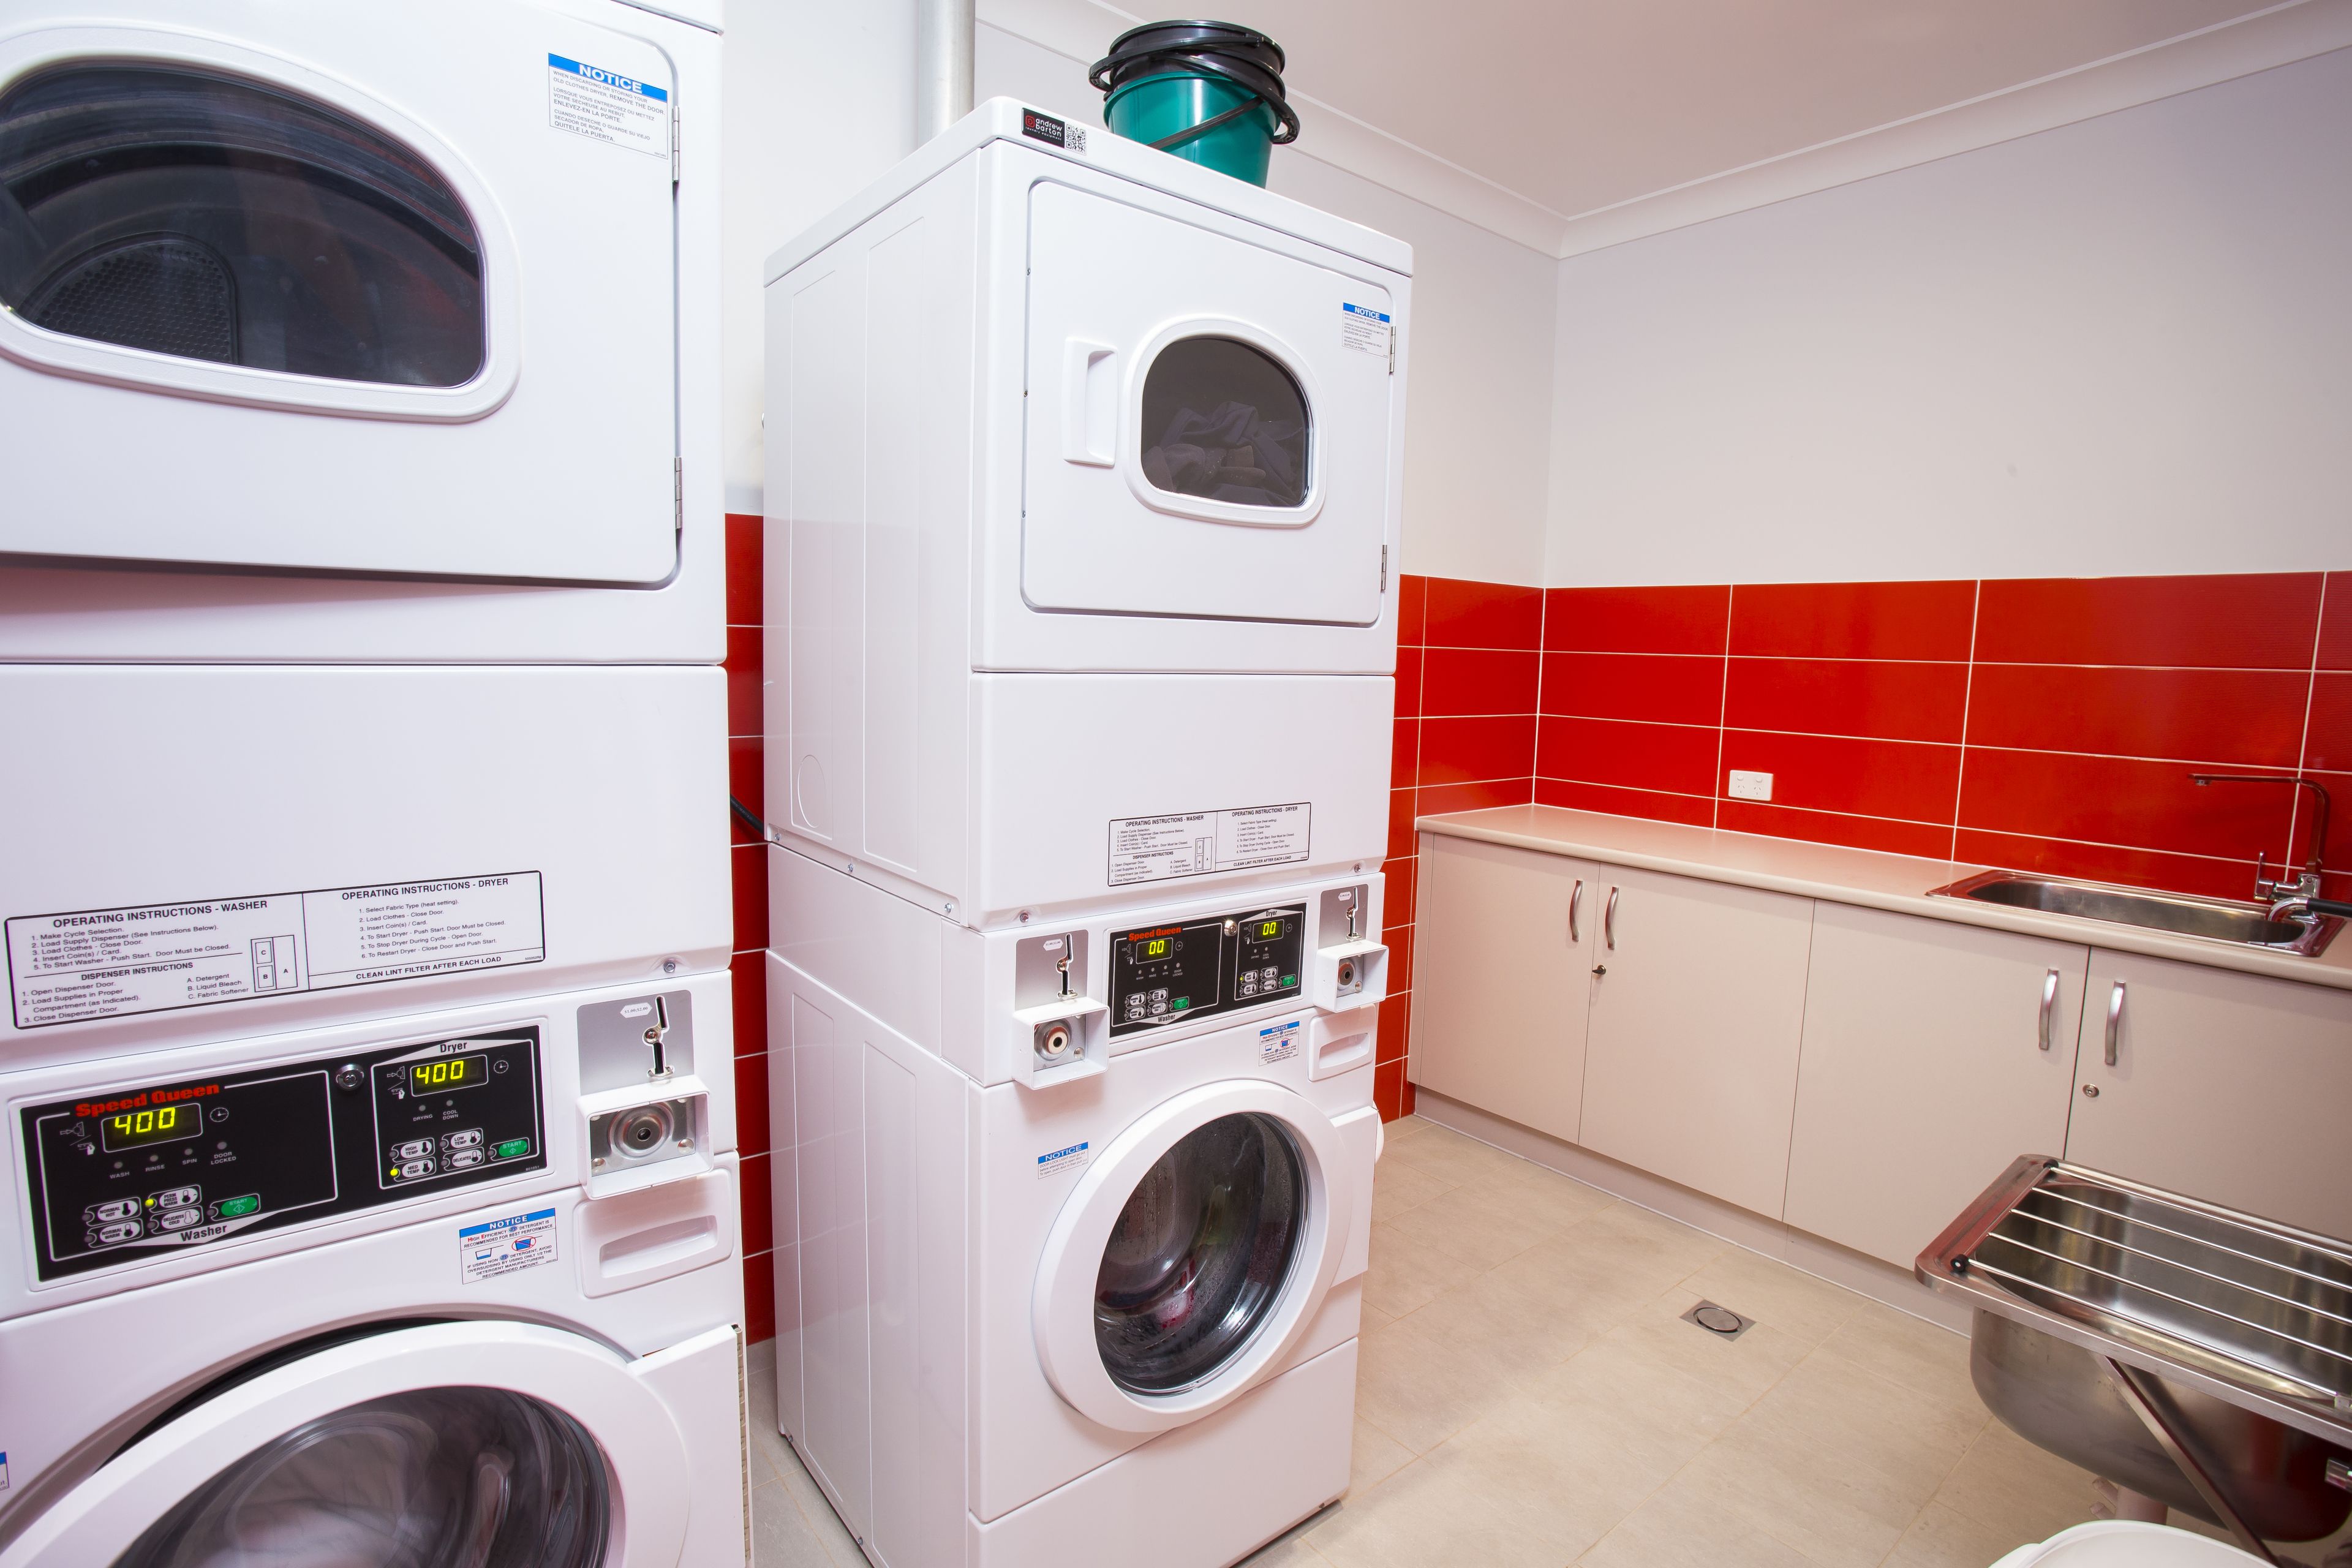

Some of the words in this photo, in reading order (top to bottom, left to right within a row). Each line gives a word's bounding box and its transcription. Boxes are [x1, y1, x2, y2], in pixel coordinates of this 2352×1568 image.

[553, 70, 569, 79] WHEN
[570, 75, 601, 89] DISCARDING
[611, 88, 633, 99] STORING
[579, 64, 642, 94] NOTICE
[553, 93, 571, 102] VOTRE
[571, 98, 599, 110] SECHEUSE
[565, 81, 589, 91] CLOTHES
[609, 94, 634, 105] REMOVE
[635, 101, 646, 110] THE
[553, 87, 578, 98] LORSQUE
[594, 99, 627, 113] ENTREPOSEZ
[635, 111, 655, 121] METTEZ
[554, 99, 590, 114] ENLEVEZ-EN
[554, 121, 580, 132] QUITELE
[1036, 118, 1062, 131] andrew
[1036, 124, 1061, 137] barton
[1042, 132, 1061, 141] equipment
[1355, 307, 1380, 319] NOTICE
[342, 888, 399, 900] OPERATING
[401, 881, 470, 894] INSTRUCTIONS
[478, 878, 508, 888] DRYER
[53, 913, 124, 928] OPERATING
[127, 905, 212, 921] INSTRUCTIONS
[221, 900, 267, 912] WASHER
[1129, 930, 1155, 942] Speed
[1156, 927, 1181, 937] Queen
[1263, 922, 1276, 935] 00
[1149, 940, 1164, 955] 00
[81, 969, 130, 981] DISPENSER
[132, 962, 194, 974] INSTRUCTIONS
[195, 973, 229, 982] Detergent
[356, 971, 383, 979] CLEAN
[55, 984, 94, 993] Dispenser
[1158, 1014, 1175, 1022] Washer
[440, 1042, 467, 1054] Dryer
[416, 1060, 464, 1084] 400
[76, 1093, 147, 1117] Speed
[151, 1084, 219, 1104] Queen
[115, 1107, 176, 1135] 400
[211, 1156, 236, 1165] LOCKED
[453, 1155, 472, 1163] DELICATES
[1046, 1145, 1082, 1161] NOTICE
[489, 1215, 528, 1229] NOTICE
[102, 1227, 122, 1237] NORMAL
[181, 1224, 227, 1242] Washer
[464, 1237, 499, 1248] RECOMMENDED
[521, 1224, 553, 1235] PERFORMANCE
[481, 1230, 507, 1239] EFFICIENCY
[519, 1221, 545, 1230] DETERGENT
[476, 1265, 504, 1276] DETERGENT
[505, 1256, 545, 1268] MANUFACTURERS
[482, 1270, 505, 1278] RECOMMENDED
[505, 1262, 540, 1273] AMOUNT.
